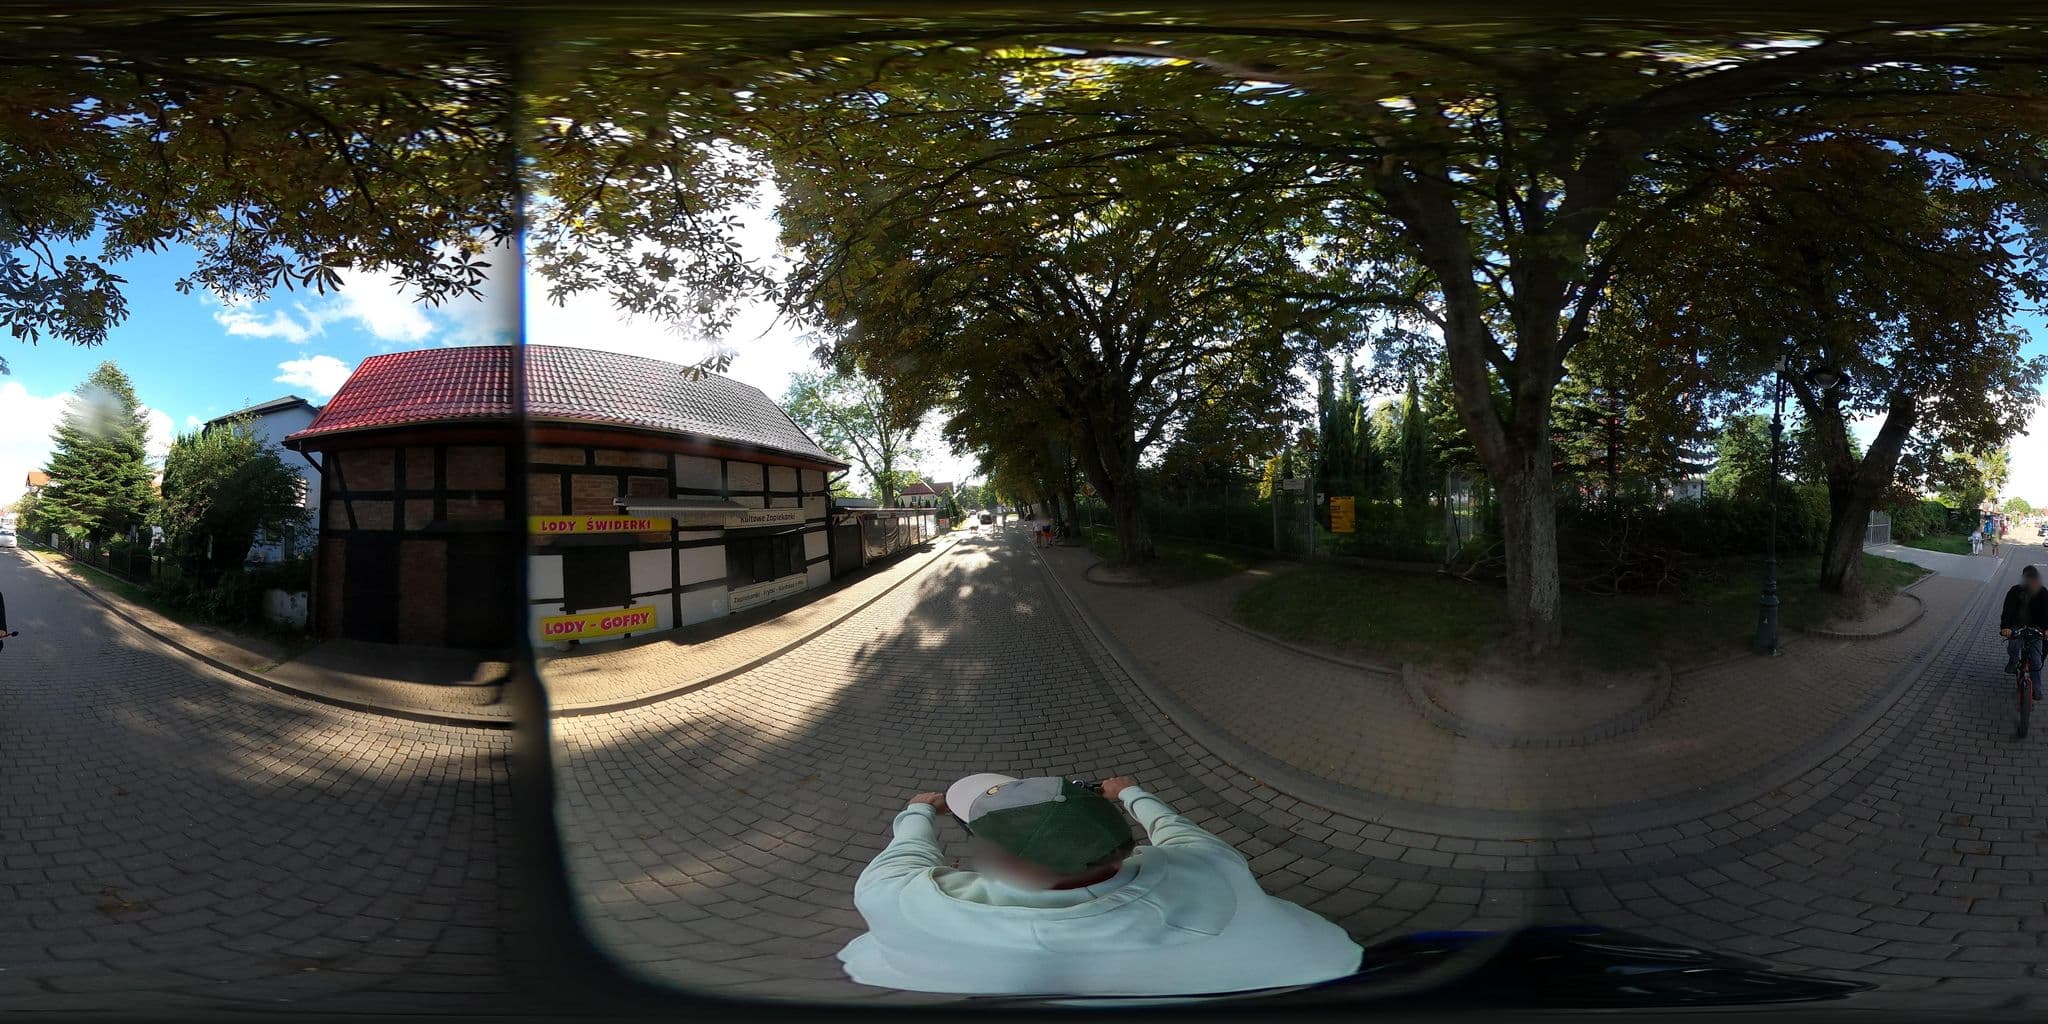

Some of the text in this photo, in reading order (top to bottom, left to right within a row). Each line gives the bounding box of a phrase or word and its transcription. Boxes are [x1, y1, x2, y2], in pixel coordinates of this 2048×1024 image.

[542, 516, 650, 531] LODY ŚWIDERKI
[545, 620, 586, 634] LODY
[600, 612, 649, 630] GOFRY
